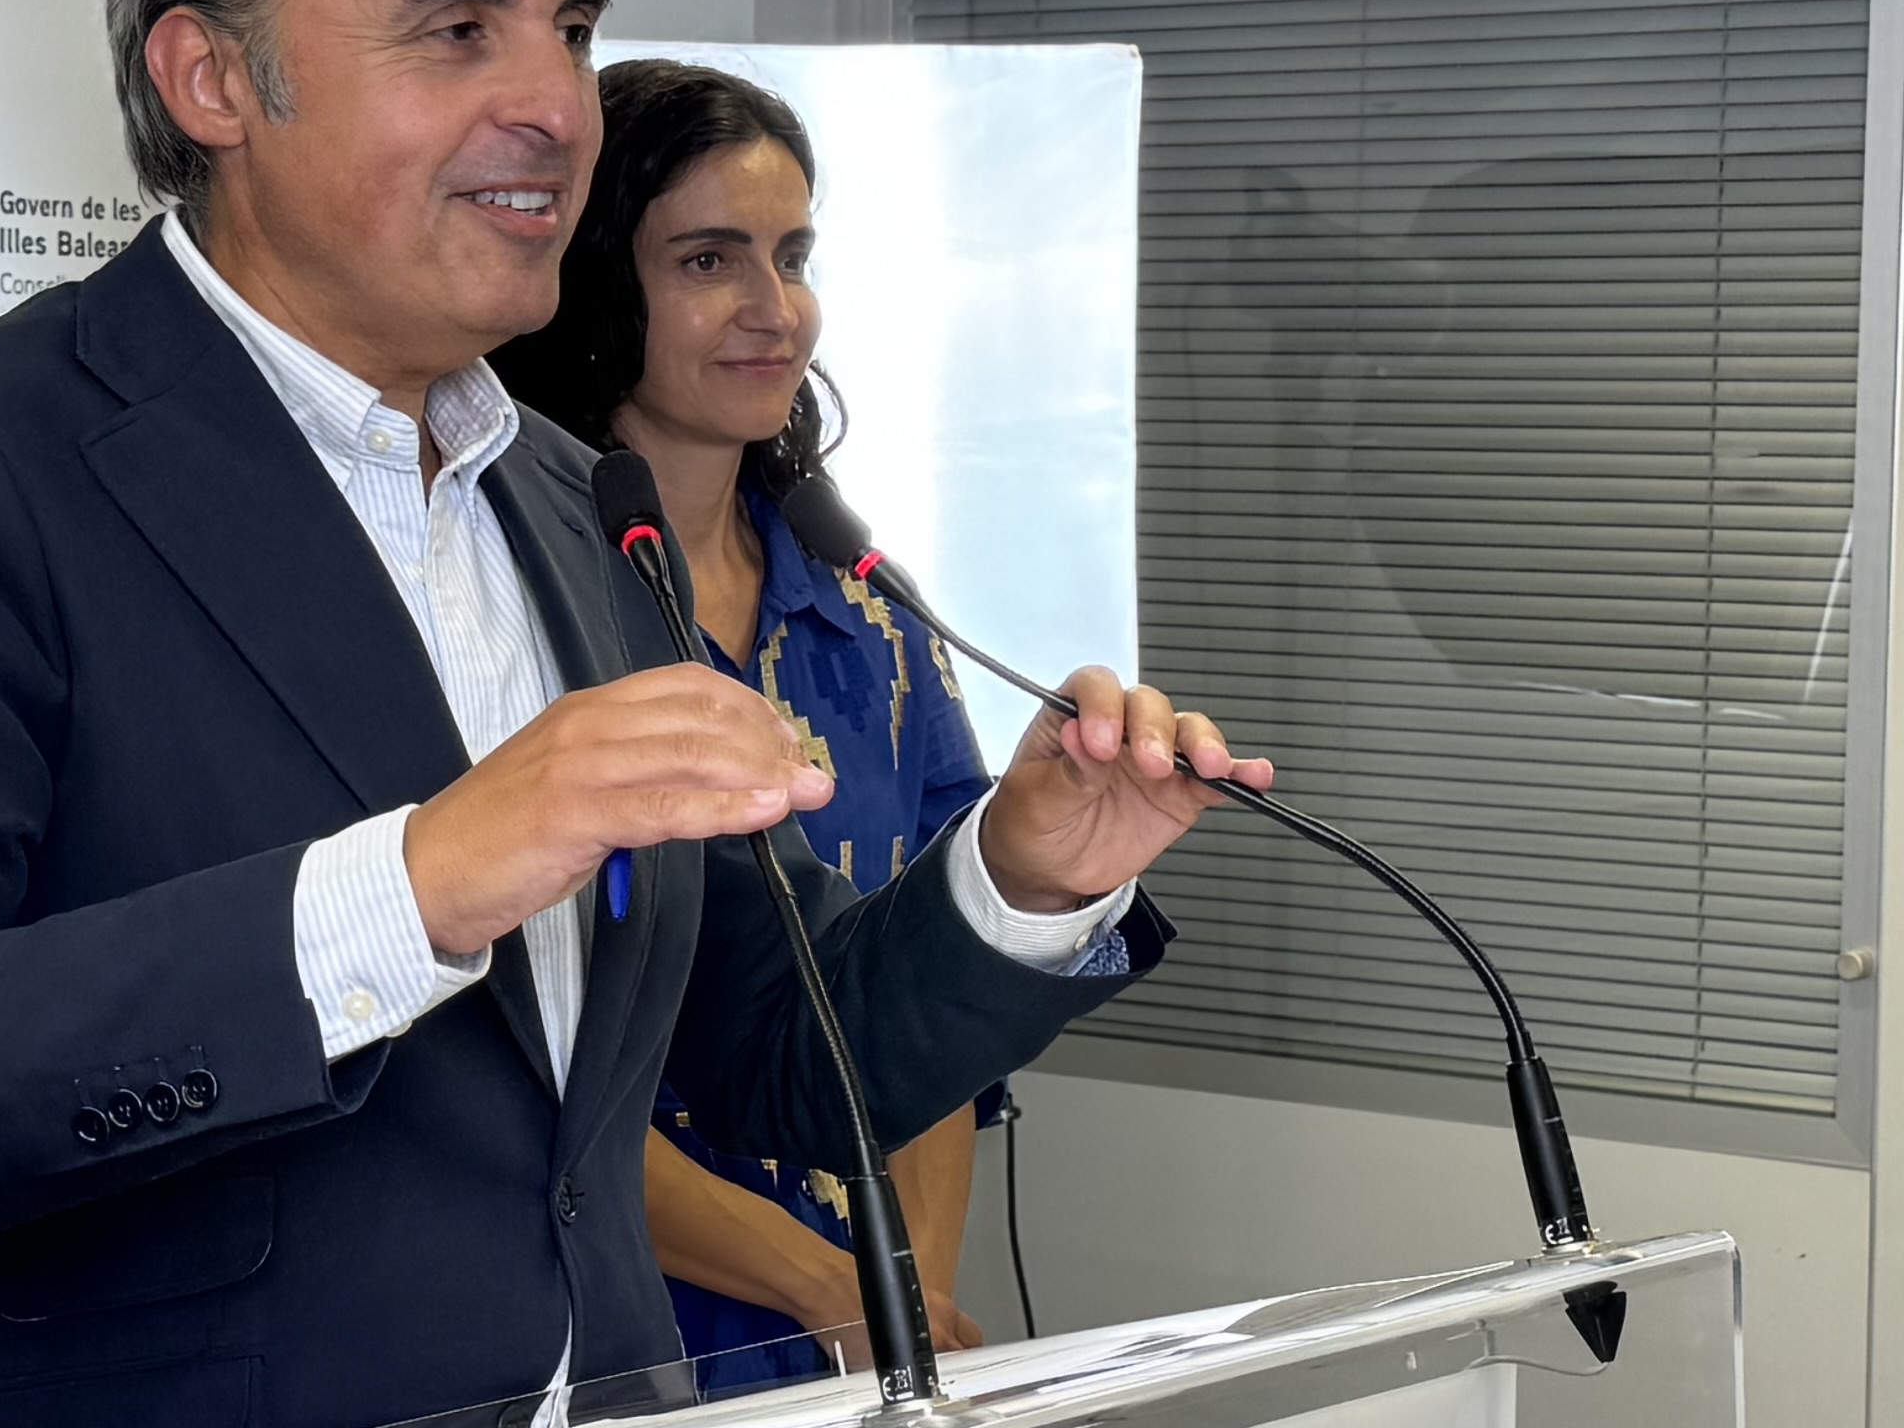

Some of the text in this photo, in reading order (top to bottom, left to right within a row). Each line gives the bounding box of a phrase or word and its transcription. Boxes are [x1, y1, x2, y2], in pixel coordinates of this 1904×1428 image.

[0, 190, 141, 221] Govern de les
[0, 227, 128, 258] Illes Balear
